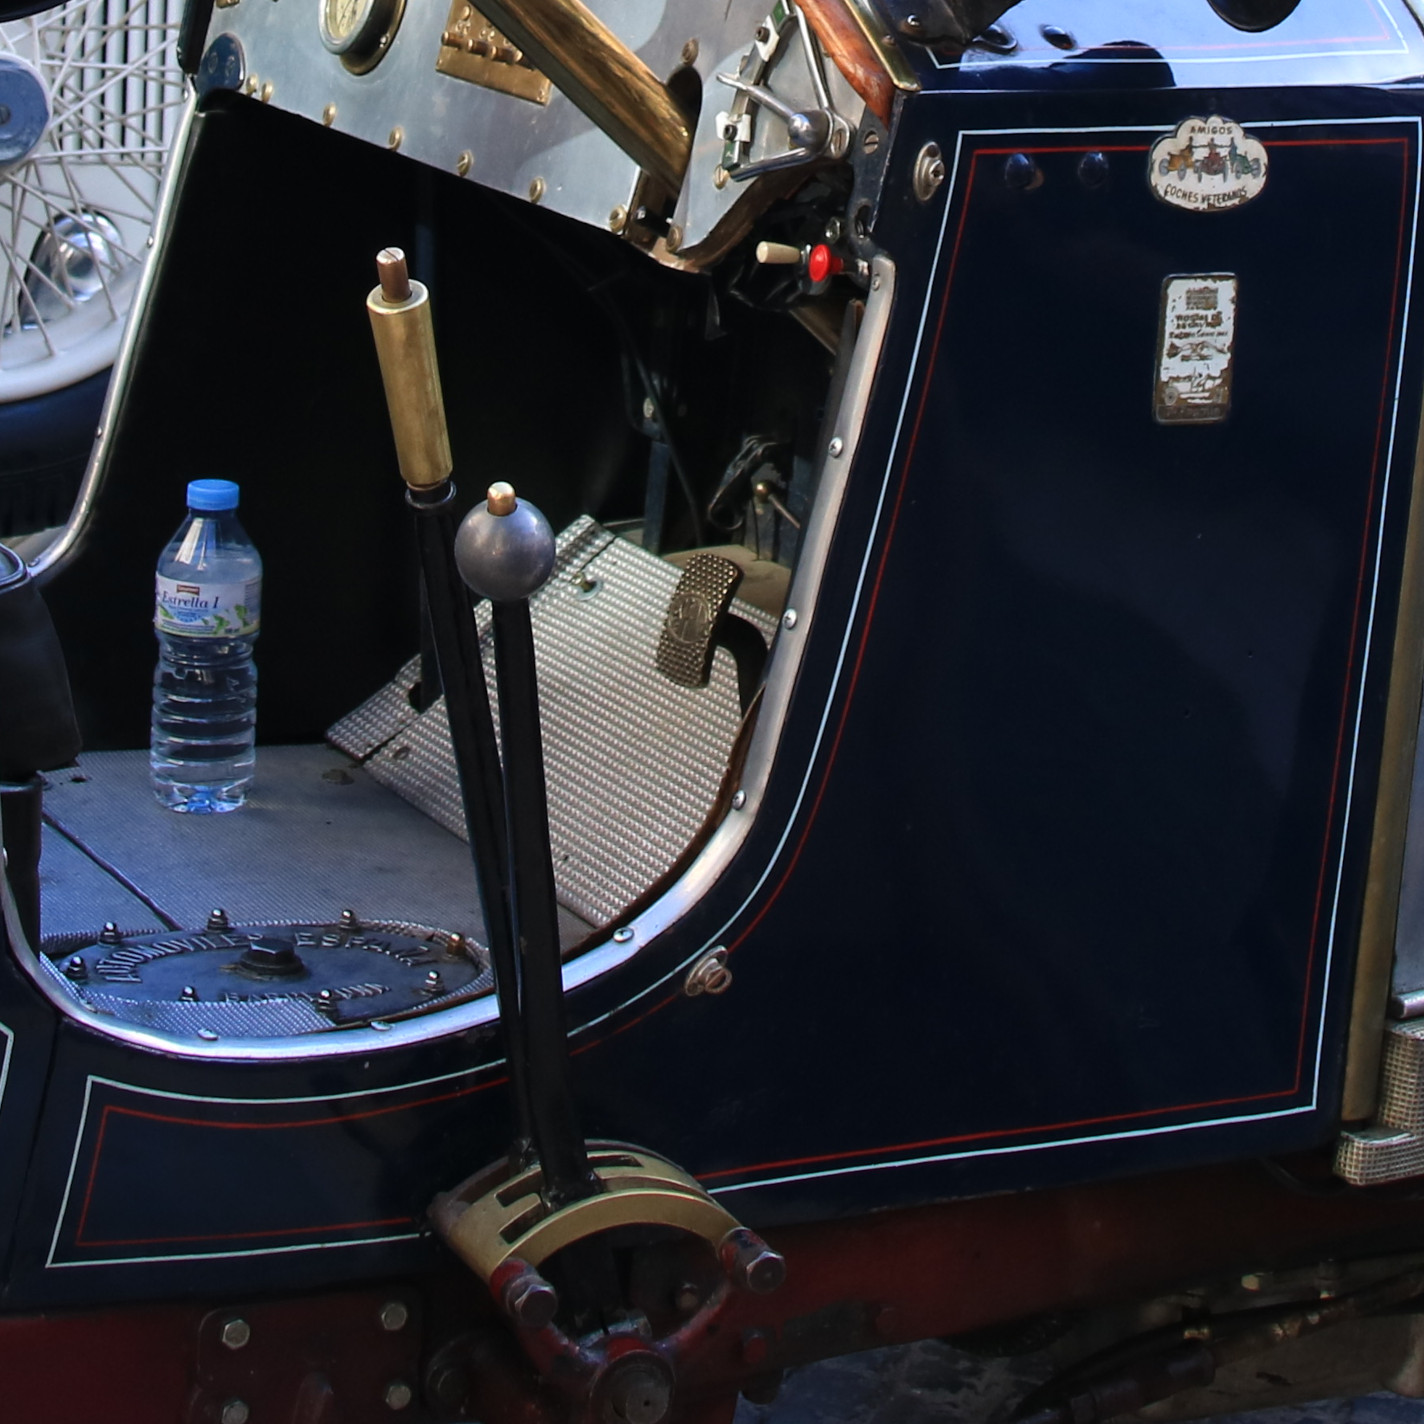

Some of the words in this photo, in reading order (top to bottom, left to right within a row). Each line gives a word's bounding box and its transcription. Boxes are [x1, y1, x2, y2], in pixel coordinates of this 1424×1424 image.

[1190, 126, 1233, 135] AMIGOS
[1164, 183, 1199, 204] COCHES
[162, 590, 208, 608] Estrella
